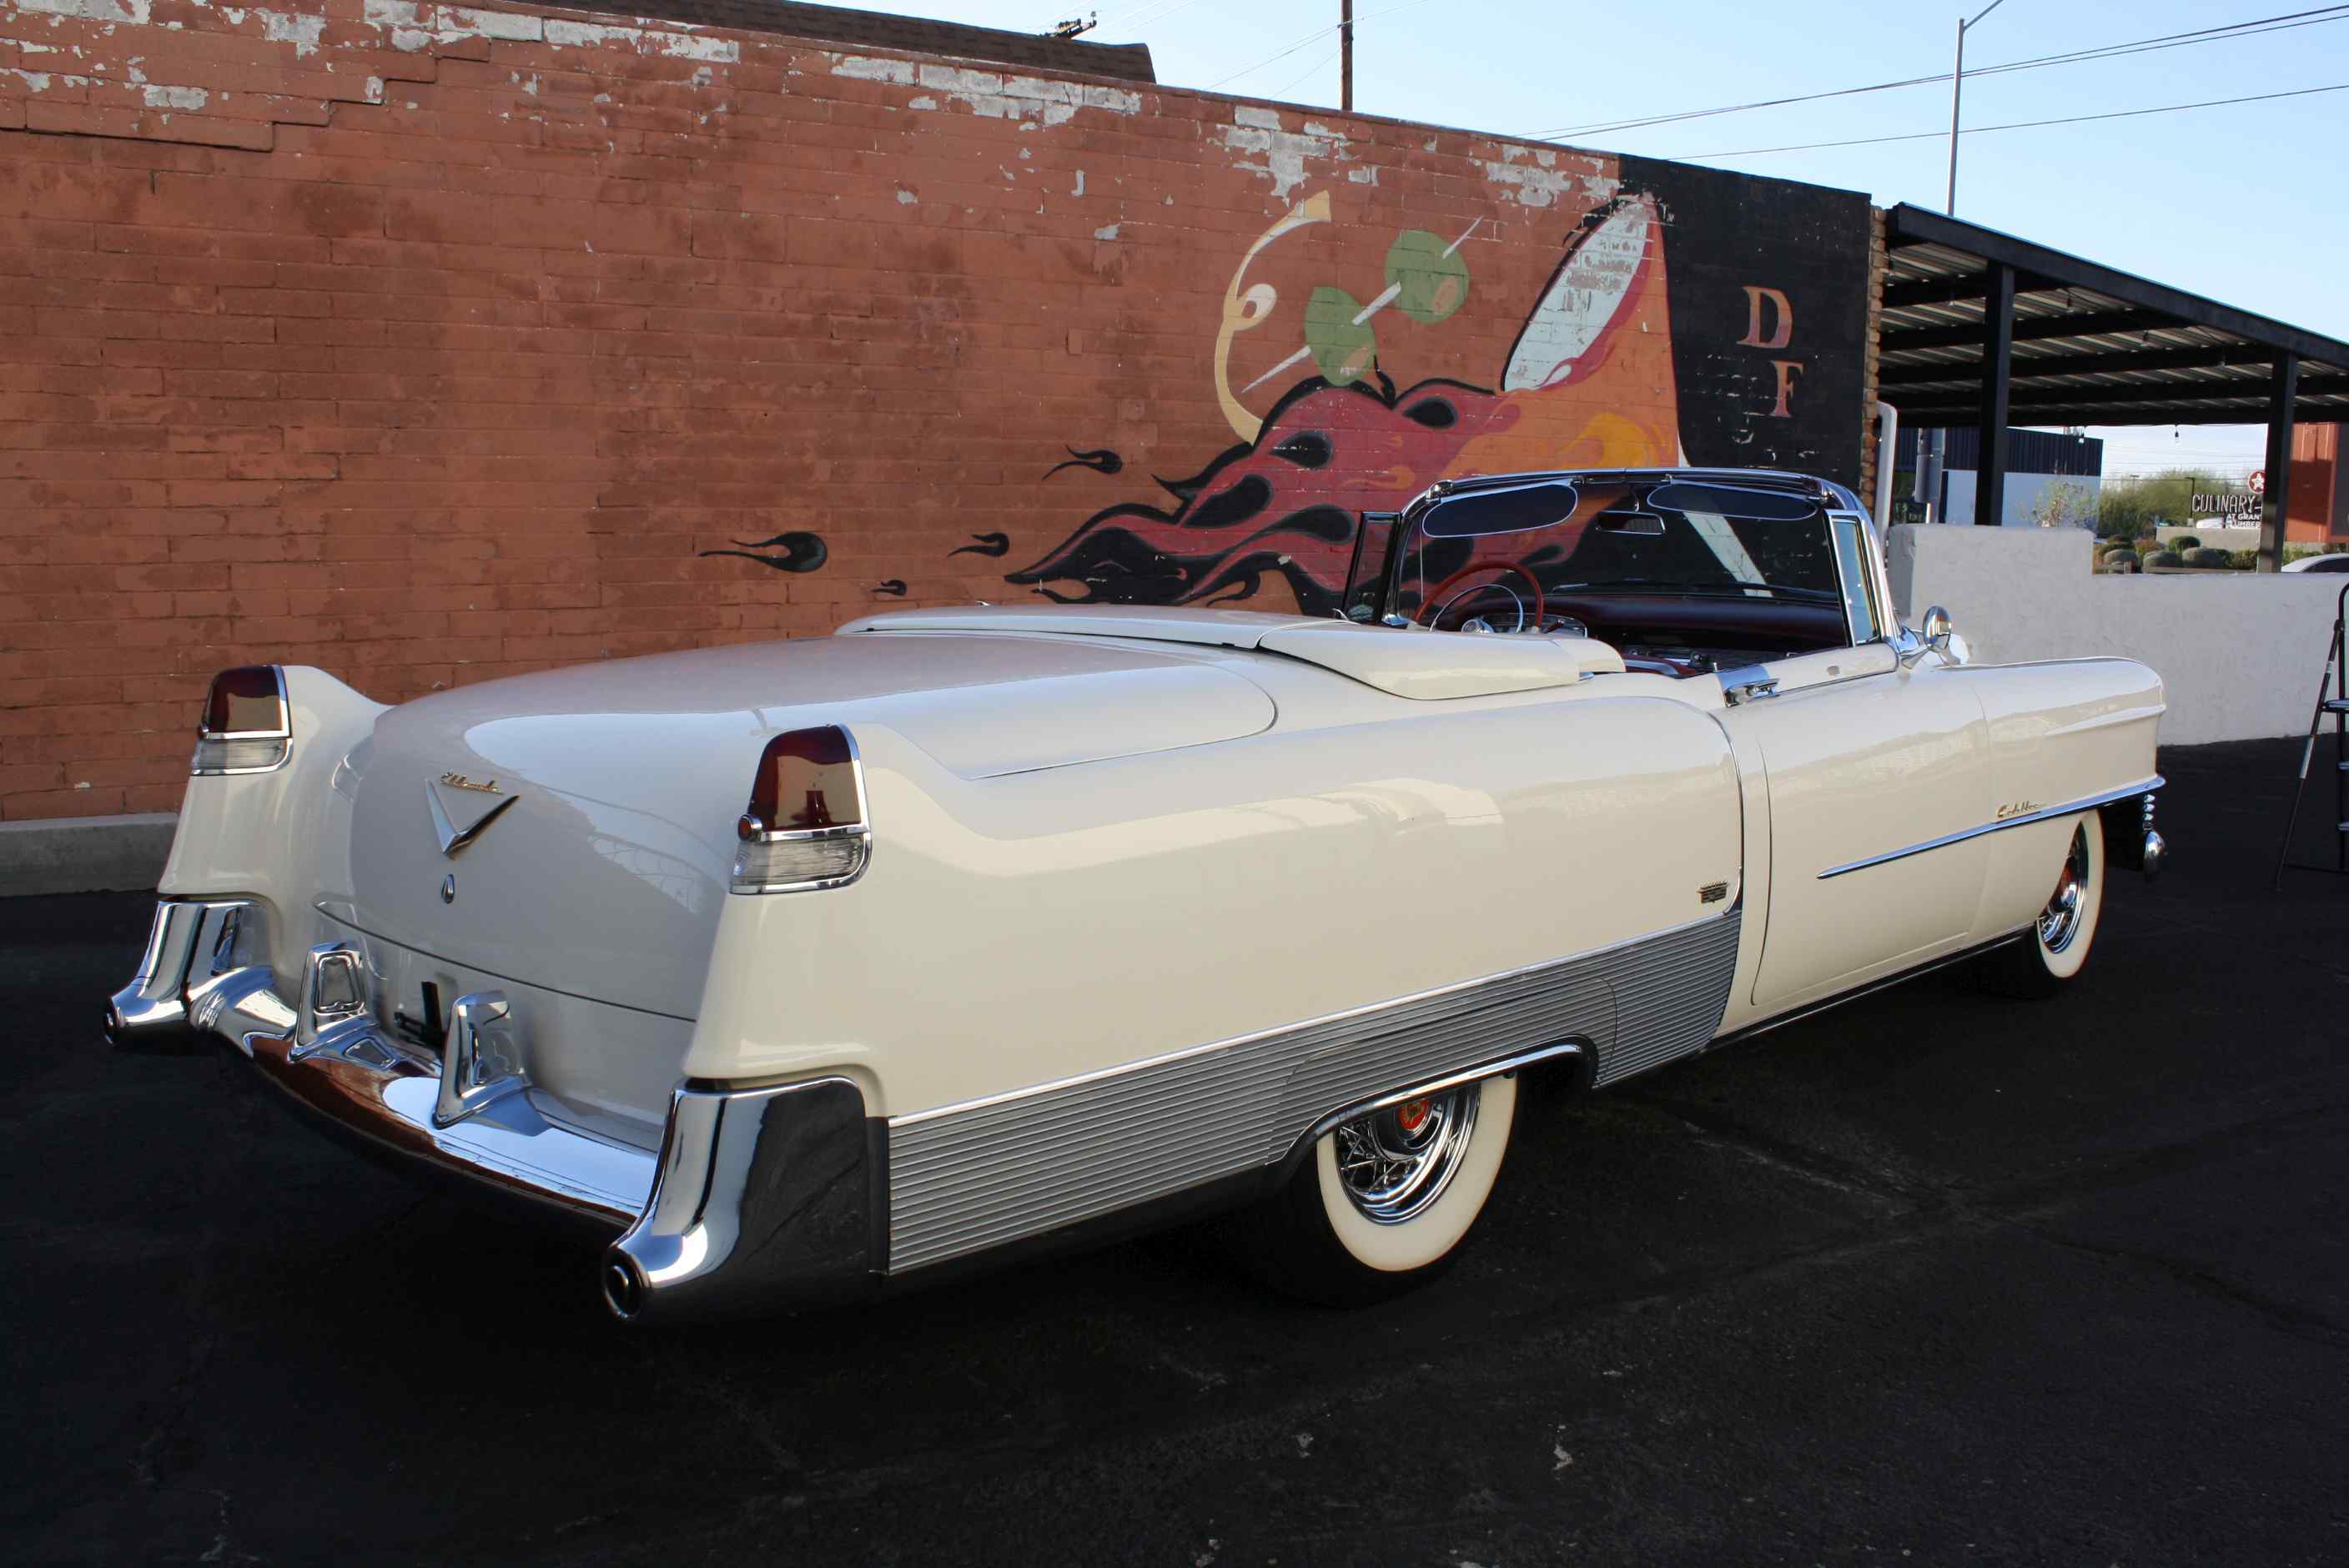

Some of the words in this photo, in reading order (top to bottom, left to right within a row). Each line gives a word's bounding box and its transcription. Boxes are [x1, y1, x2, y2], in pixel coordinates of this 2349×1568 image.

[1736, 285, 1793, 349] D
[1769, 360, 1804, 418] F
[2192, 494, 2256, 513] CULINARY
